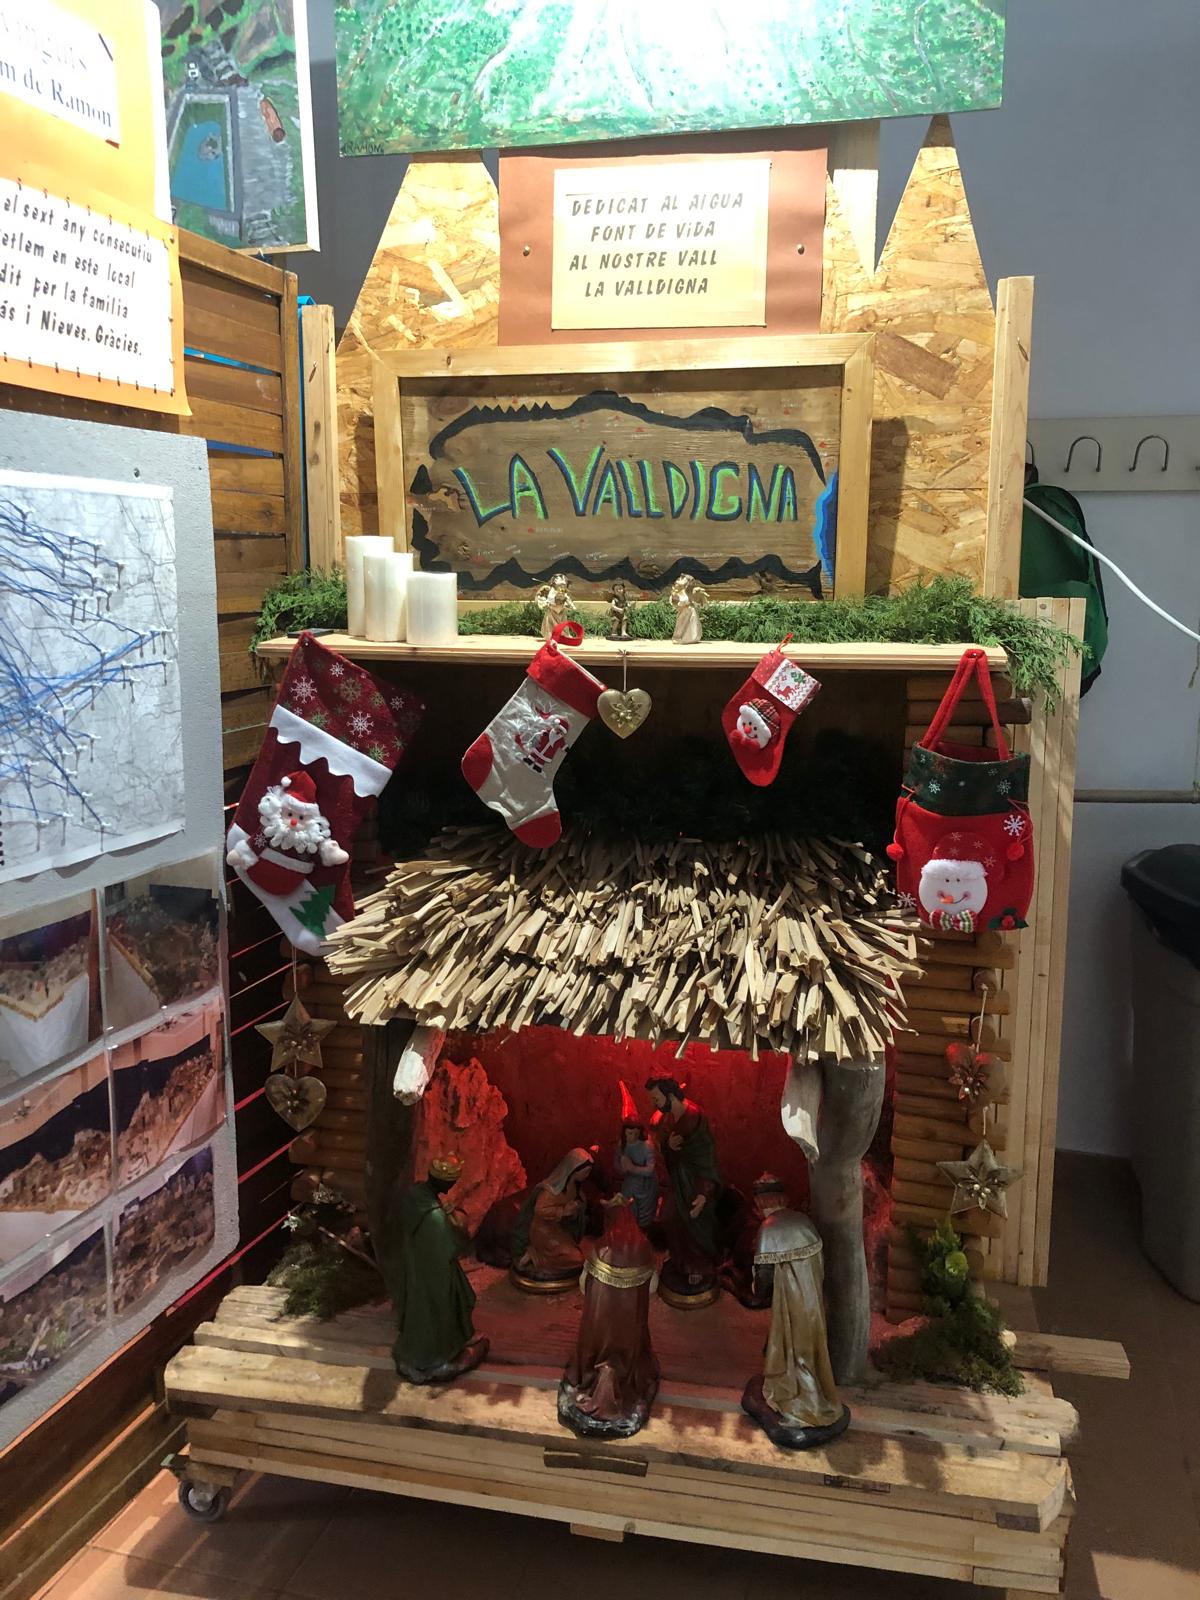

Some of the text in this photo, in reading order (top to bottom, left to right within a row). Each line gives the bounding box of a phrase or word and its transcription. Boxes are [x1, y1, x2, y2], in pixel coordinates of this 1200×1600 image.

[51, 78, 112, 128] Ramon
[571, 192, 744, 217] DEDICAT AL AIGUA
[4, 194, 152, 263] el sext any consecutiu
[590, 224, 637, 242] FONT
[645, 222, 667, 239] DE
[0, 231, 135, 288] etlem en este local
[569, 249, 718, 271] AL NOSTRE VALL
[33, 277, 57, 298] per
[64, 281, 76, 302] la
[82, 285, 128, 318] familia
[585, 278, 709, 297] LA VALLDIGNA
[26, 304, 31, 325] i
[41, 309, 90, 342] Nieves.
[95, 324, 142, 356] Gràcies.
[452, 445, 799, 528] LA VALLDIGNA
